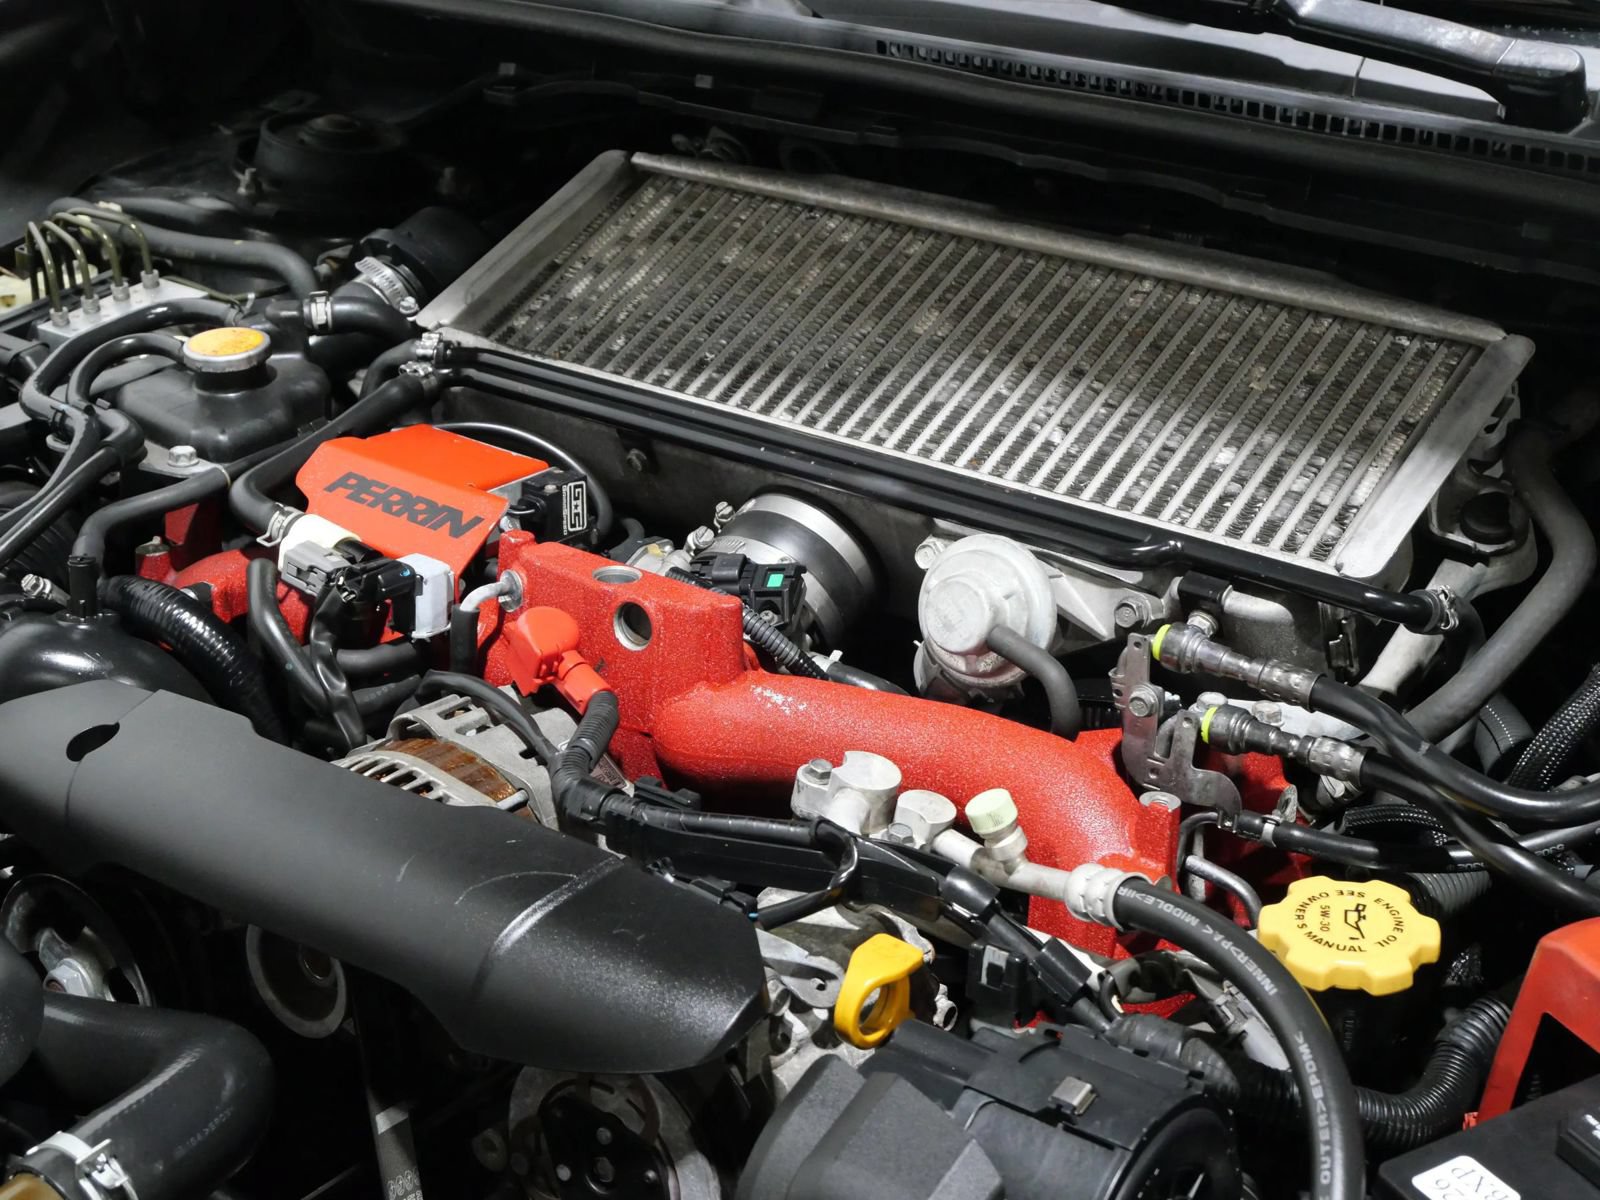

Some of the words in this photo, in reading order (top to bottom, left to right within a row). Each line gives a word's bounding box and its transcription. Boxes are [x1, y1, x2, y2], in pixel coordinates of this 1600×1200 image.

[323, 471, 485, 539] PERRIN
[1335, 889, 1367, 898] SEE
[1373, 897, 1405, 934] ENGINE
[1304, 930, 1368, 952] MANUAL
[1374, 934, 1398, 947] OIL
